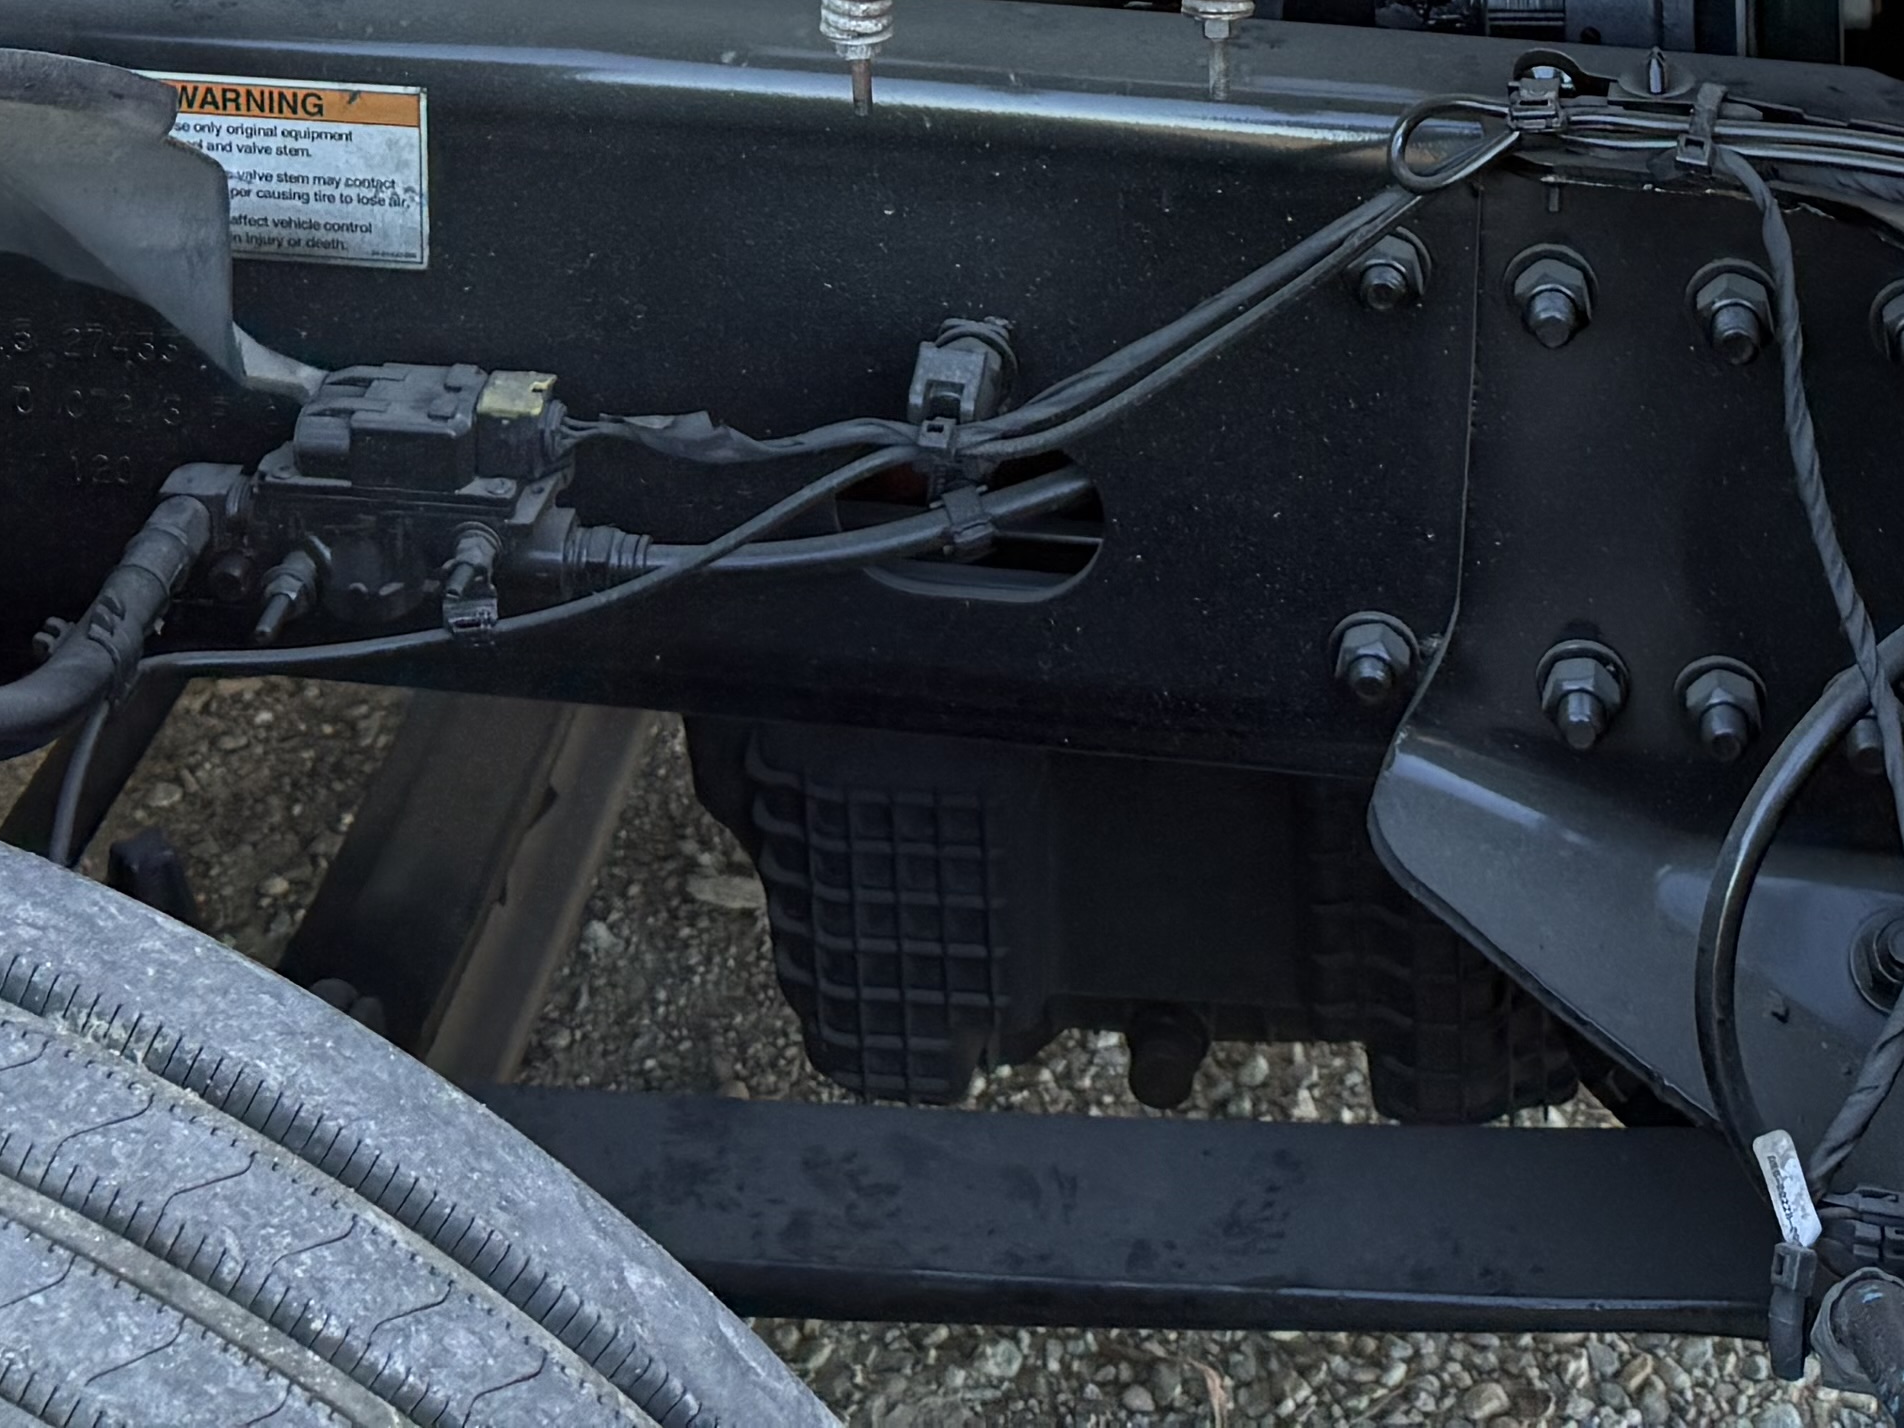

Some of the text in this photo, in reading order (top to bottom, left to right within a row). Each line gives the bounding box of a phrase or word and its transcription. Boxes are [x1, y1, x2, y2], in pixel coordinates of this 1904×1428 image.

[177, 83, 325, 117] WARNING
[193, 121, 228, 137] only
[226, 122, 278, 139] original
[281, 127, 353, 142] equipment
[207, 139, 233, 154] and
[236, 141, 273, 156] valve
[275, 144, 313, 158] stem.
[236, 168, 396, 191] valve stem may contact
[256, 186, 310, 204] causing
[313, 190, 337, 204] tire
[339, 191, 353, 205] to
[356, 192, 387, 207] lose
[229, 211, 373, 234] affect vehicle control
[245, 233, 285, 251] injury
[287, 238, 302, 250] or
[304, 236, 347, 252] death.
